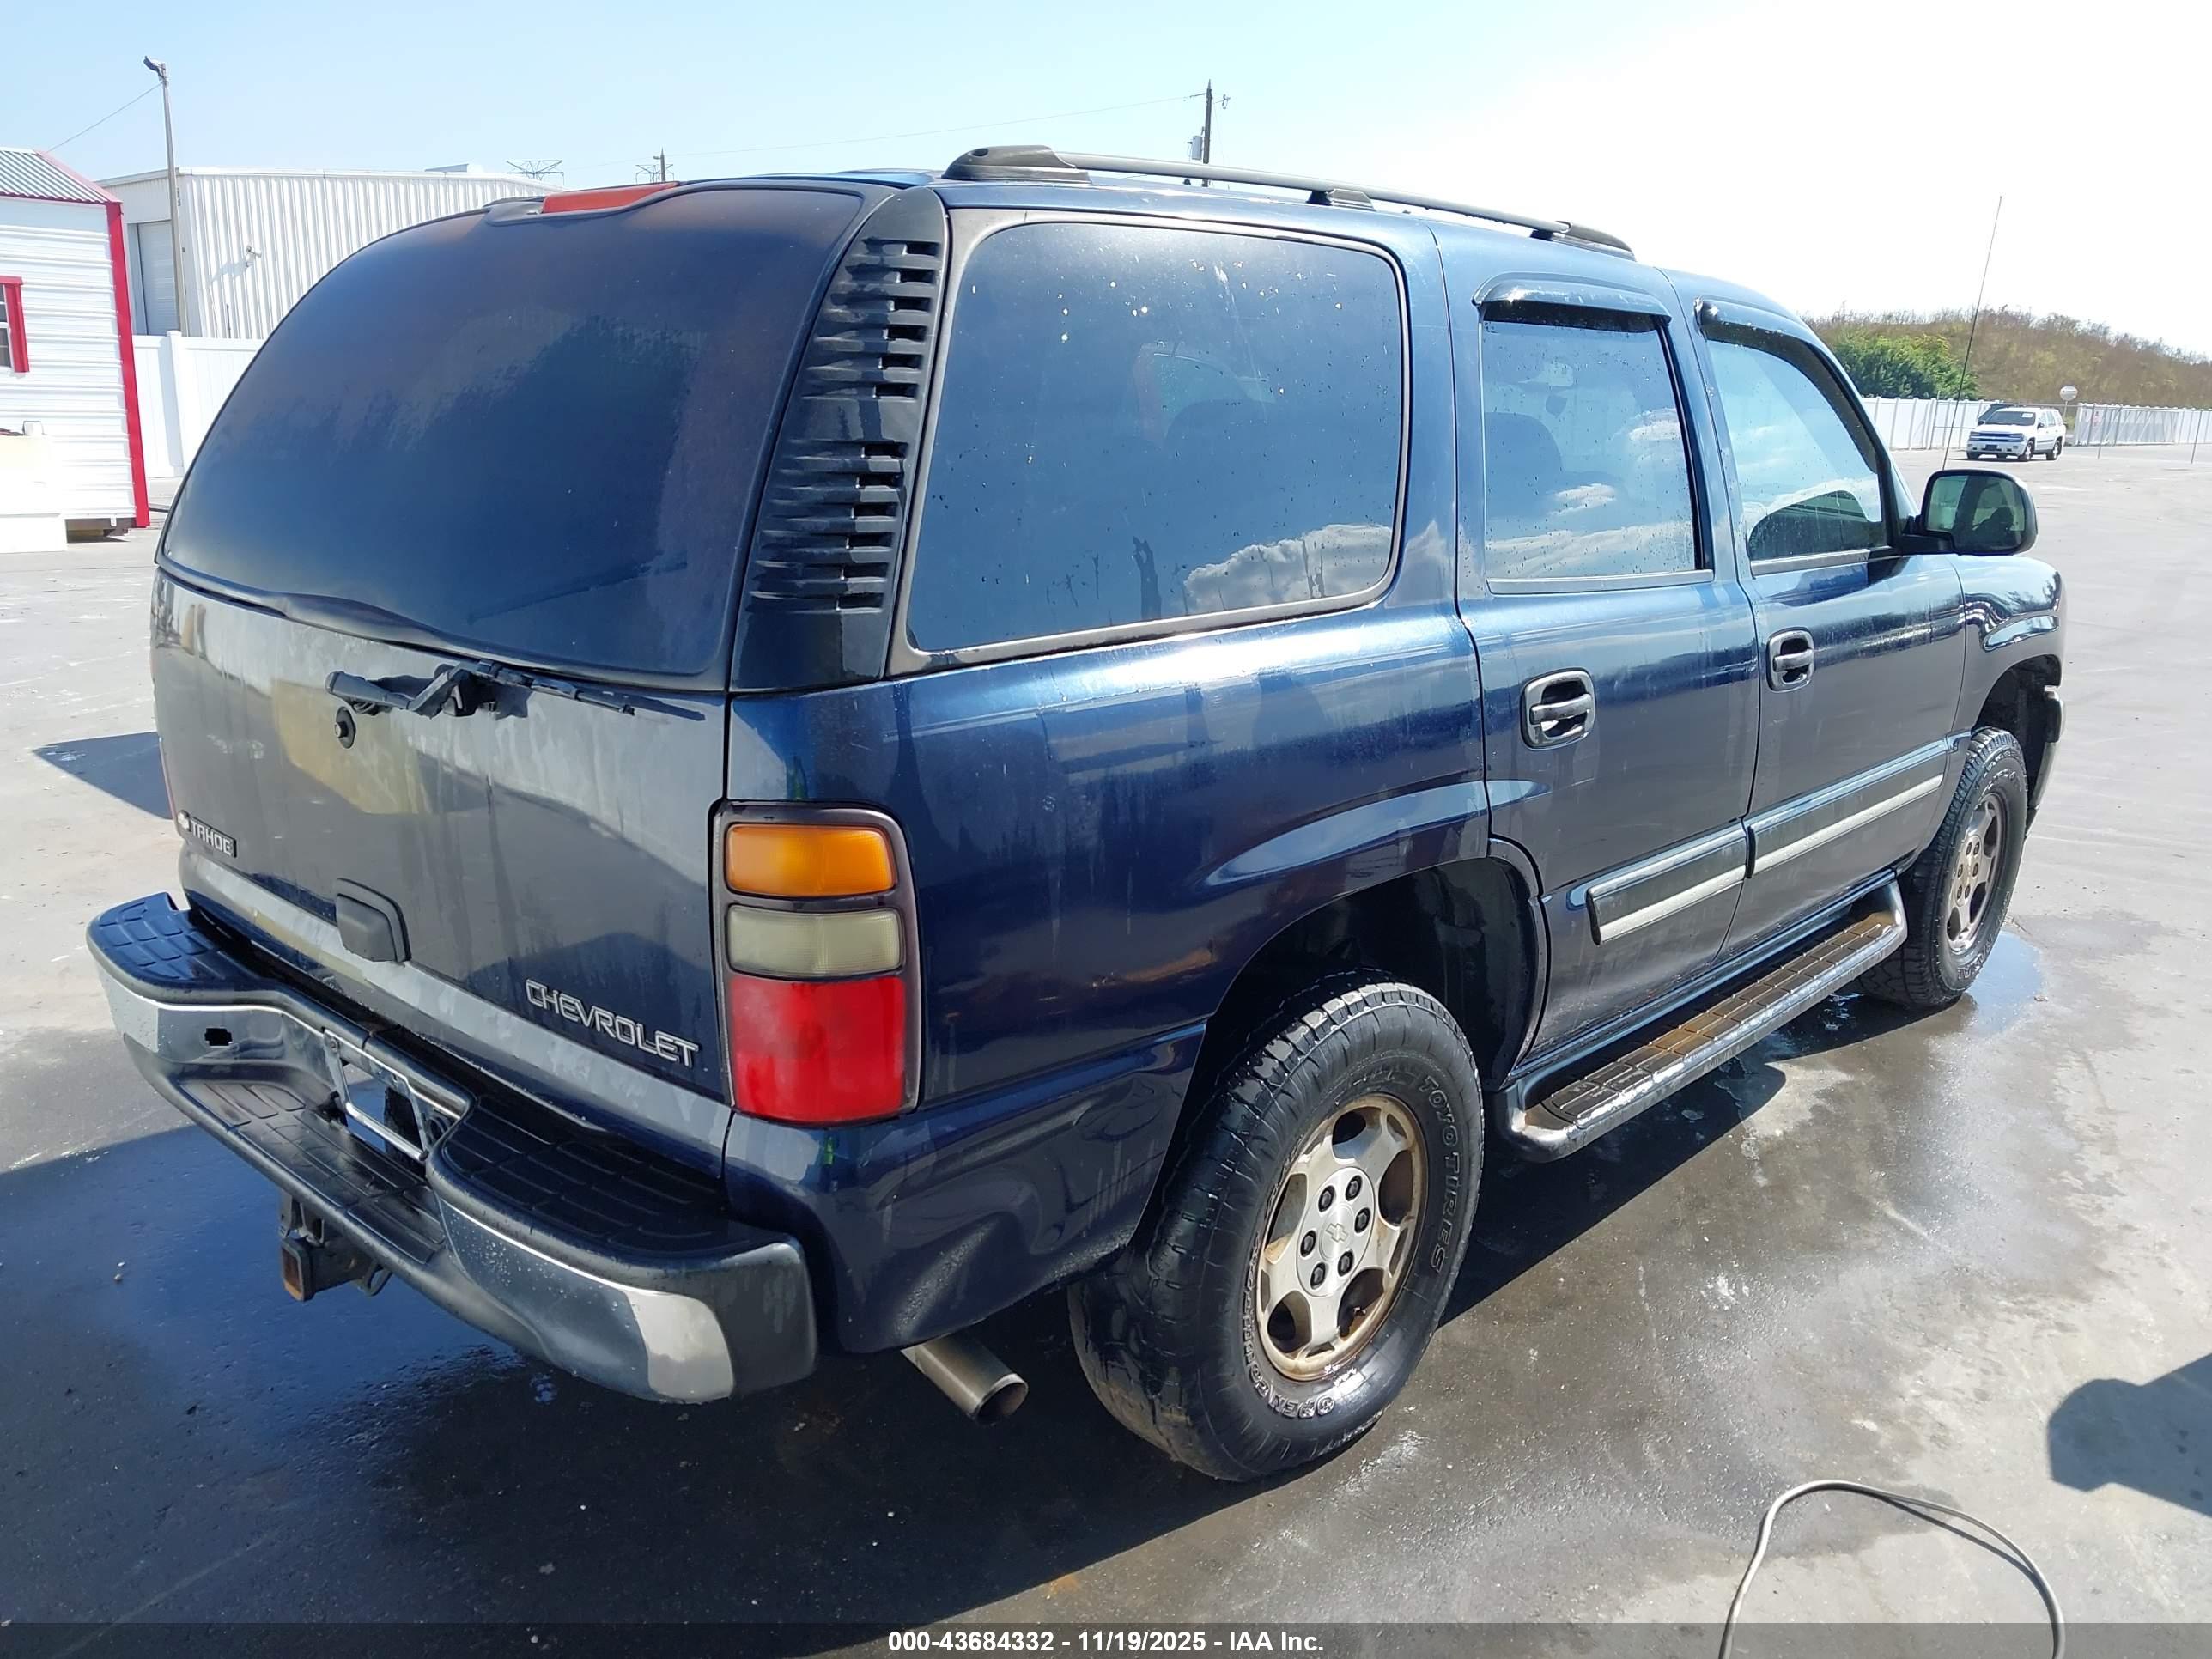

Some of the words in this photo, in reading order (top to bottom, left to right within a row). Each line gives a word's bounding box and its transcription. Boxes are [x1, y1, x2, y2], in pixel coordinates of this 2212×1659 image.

[190, 818, 232, 856] TAHOE
[526, 978, 700, 1067] CHEVROLET
[1418, 1074, 1459, 1147] TOYO
[1429, 1151, 1461, 1274] TIRES
[1267, 1382, 1335, 1419] OPEN
